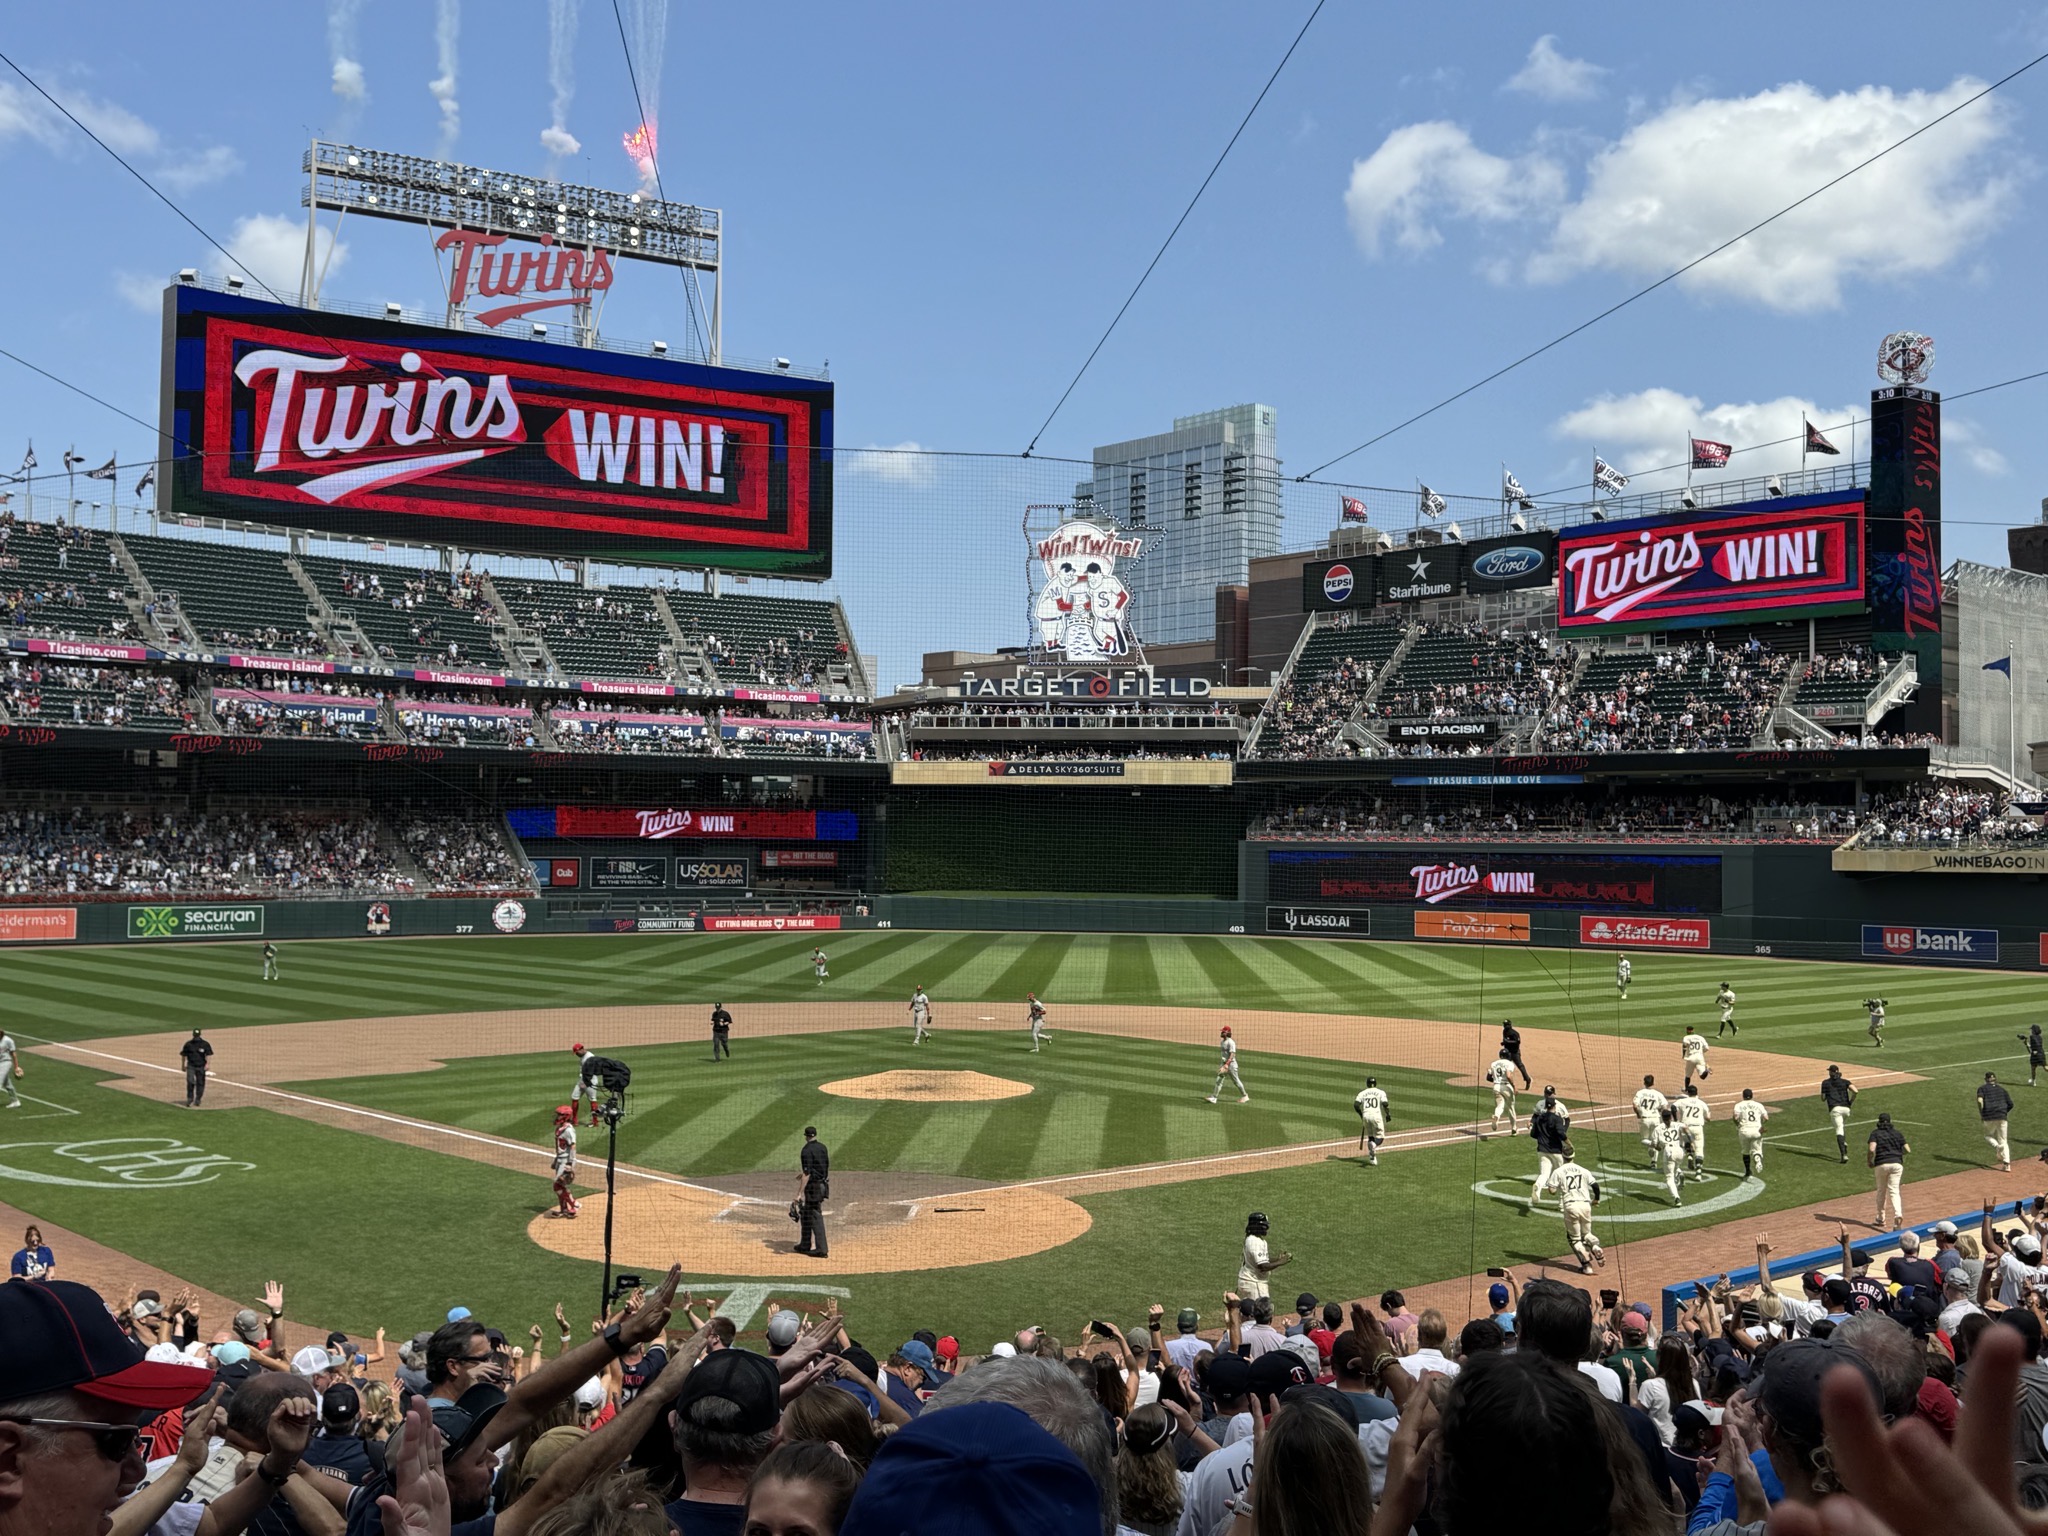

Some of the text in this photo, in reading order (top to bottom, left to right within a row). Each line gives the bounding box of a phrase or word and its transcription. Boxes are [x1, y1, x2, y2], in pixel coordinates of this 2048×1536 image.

[436, 228, 614, 328] Twins
[1878, 388, 1895, 399] 3:10
[1921, 390, 1933, 401] 3:10
[235, 348, 725, 504] Twins WIN!
[1038, 534, 1141, 559] Win! Twins!
[1486, 551, 1530, 575] Ford
[1565, 529, 1819, 621] Twins WIN!
[1903, 507, 1941, 640] Twins
[1325, 577, 1352, 588] PEPSI
[241, 656, 325, 674] Treasure Island
[591, 682, 666, 696] Treasure Island
[959, 677, 1212, 697] TARGET FIELD
[427, 713, 466, 728] Home
[590, 722, 649, 737] Tasure
[1400, 724, 1485, 736] END RACISM
[1019, 765, 1052, 774] DELTA
[1427, 776, 1542, 785] TREASURE ISLAND COVE
[635, 807, 735, 839] Twins WIN!
[793, 851, 803, 860] HIT
[804, 851, 816, 860] THE
[556, 868, 574, 878] Cub
[618, 861, 637, 873] RBI
[698, 878, 745, 886] us-solar.com
[1410, 861, 1535, 904] Twins WIN!
[184, 910, 256, 923] securian
[184, 922, 236, 932] FINANCIAL
[455, 925, 474, 934] 377
[637, 919, 695, 929] COMMUNITY FUND
[715, 920, 741, 928] GETTING
[741, 920, 758, 928] MORE
[758, 920, 773, 928] KIDS
[786, 919, 797, 927] THE
[797, 919, 815, 927] GAME
[877, 920, 891, 928] 411
[1229, 925, 1245, 933] 403
[1442, 918, 1500, 936] Paycor
[1886, 929, 1974, 952] us bank
[1754, 945, 1772, 954] 365
[1689, 1040, 1701, 1051] 50
[1365, 1097, 1378, 1108] 30
[1640, 1098, 1656, 1111] 47
[1685, 1105, 1700, 1119] 72
[1747, 1110, 1756, 1122] 8
[1663, 1129, 1679, 1143] 82
[1565, 1173, 1583, 1190] 27
